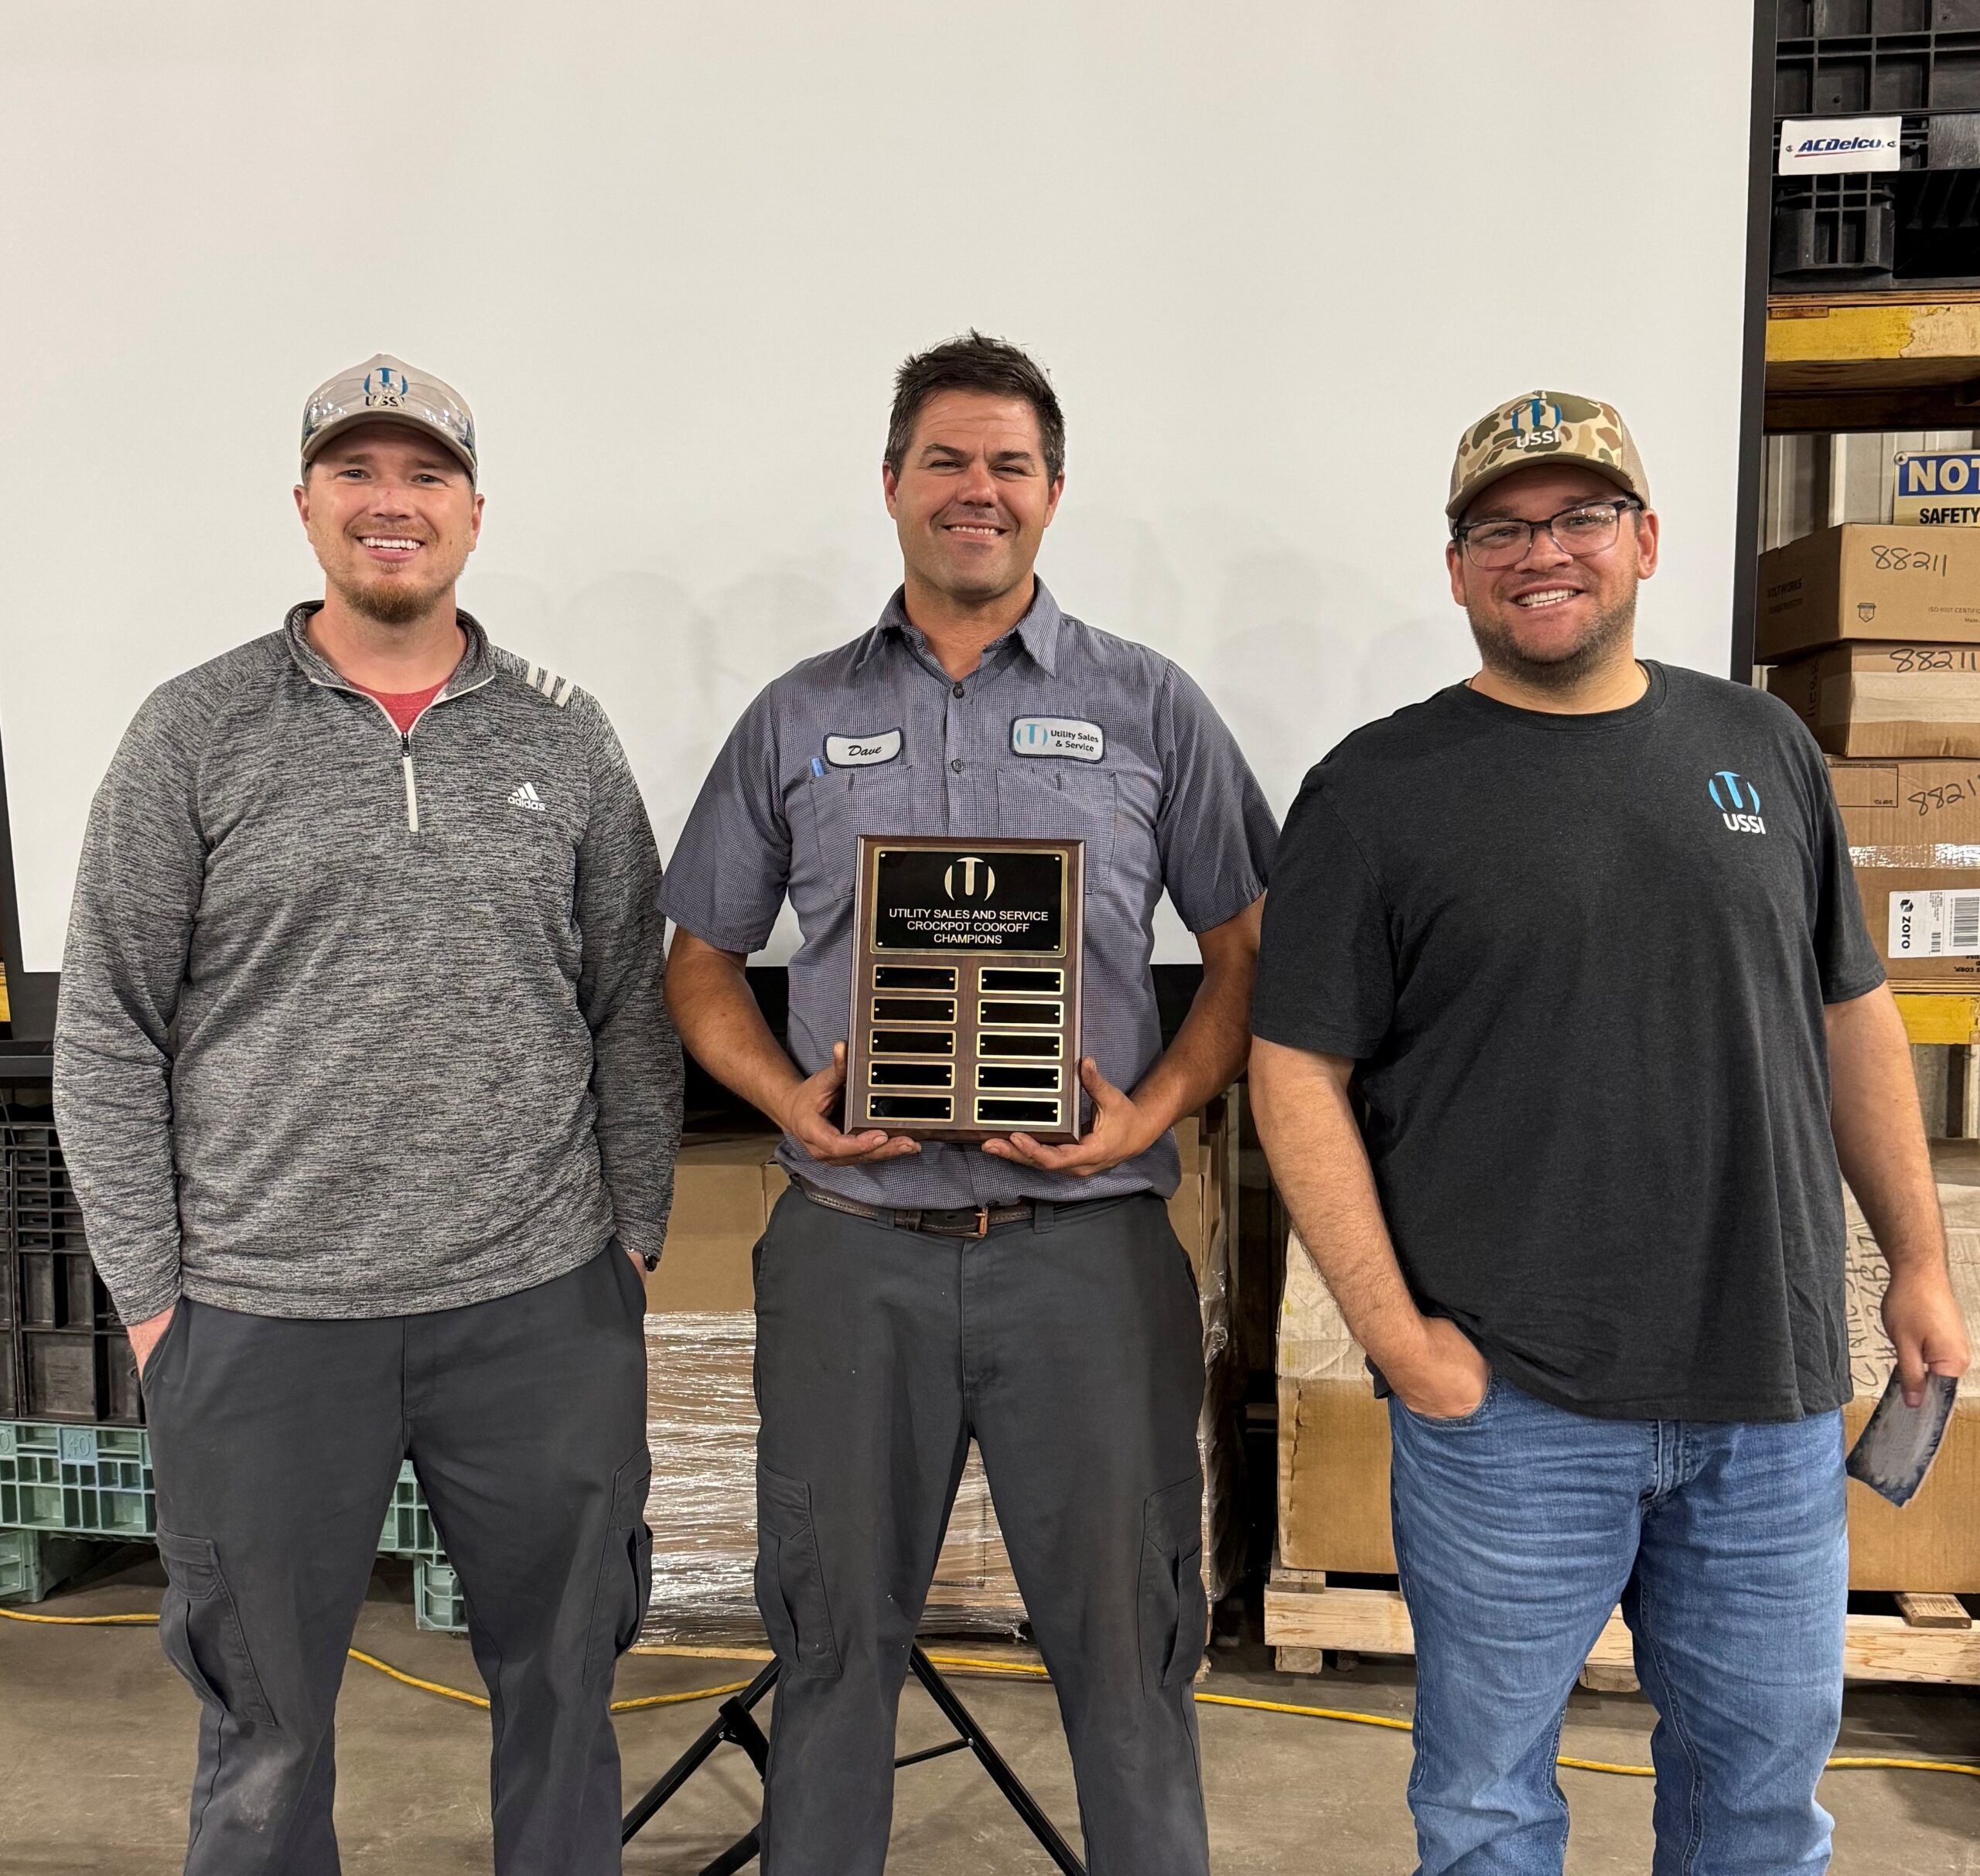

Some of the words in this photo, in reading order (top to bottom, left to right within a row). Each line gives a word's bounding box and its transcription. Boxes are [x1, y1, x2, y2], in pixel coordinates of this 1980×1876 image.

[1797, 137, 1882, 152] ACDelco
[1516, 429, 1560, 449] USSI
[1919, 507, 1980, 524] SAFETY
[1871, 545, 1947, 578] 88211
[1890, 648, 1976, 673] 88211
[1051, 730, 1076, 740] Utility
[1077, 732, 1099, 742] Sales
[848, 745, 882, 756] Dave
[1065, 741, 1094, 752] Service
[1907, 774, 1980, 816] 8821
[507, 796, 545, 811] adidas
[1722, 813, 1767, 835] USSI
[889, 908, 930, 919] UTILITY
[934, 909, 970, 919] SALES
[971, 910, 996, 920] AND
[999, 911, 1049, 921] SERVICE
[906, 921, 971, 932] CROCKPOT
[974, 923, 1030, 933] COOKOFF
[1901, 916, 1911, 950] zoro
[934, 933, 1002, 944] CHAMPIONS
